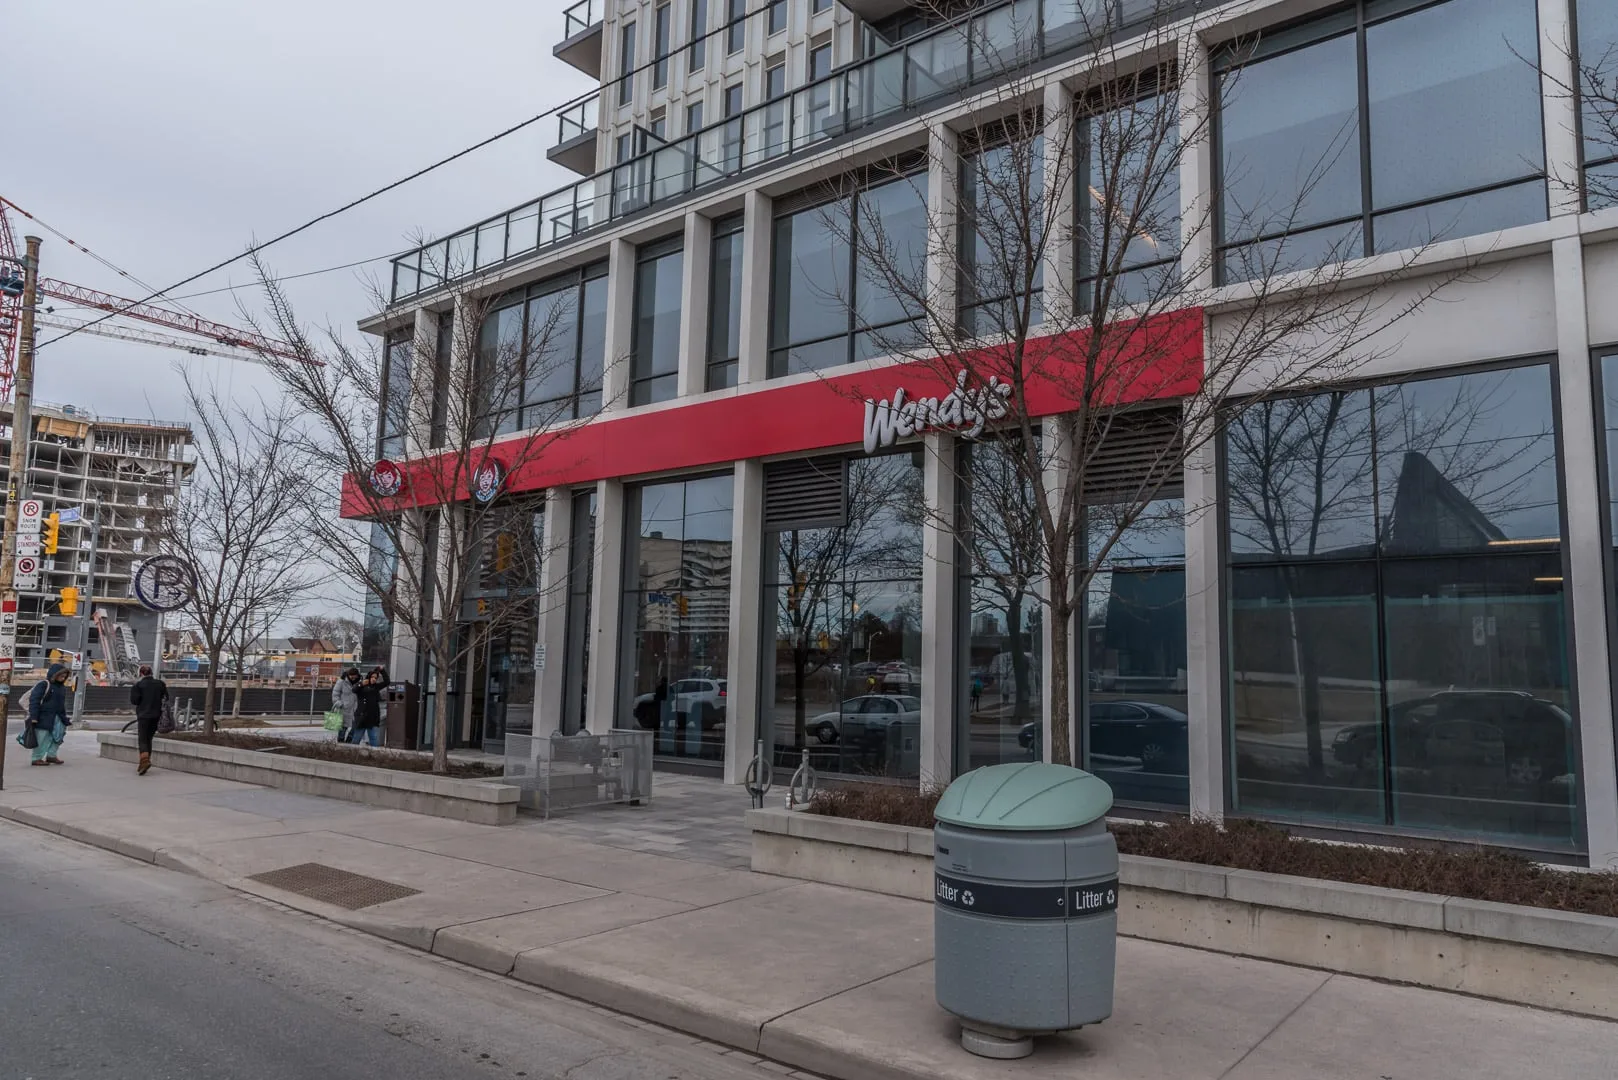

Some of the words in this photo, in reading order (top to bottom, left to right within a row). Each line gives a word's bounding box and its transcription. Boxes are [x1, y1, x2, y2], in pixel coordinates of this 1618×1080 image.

[863, 368, 1012, 454] Wendy's
[936, 876, 959, 902] Litter
[1075, 890, 1104, 910] Litter
